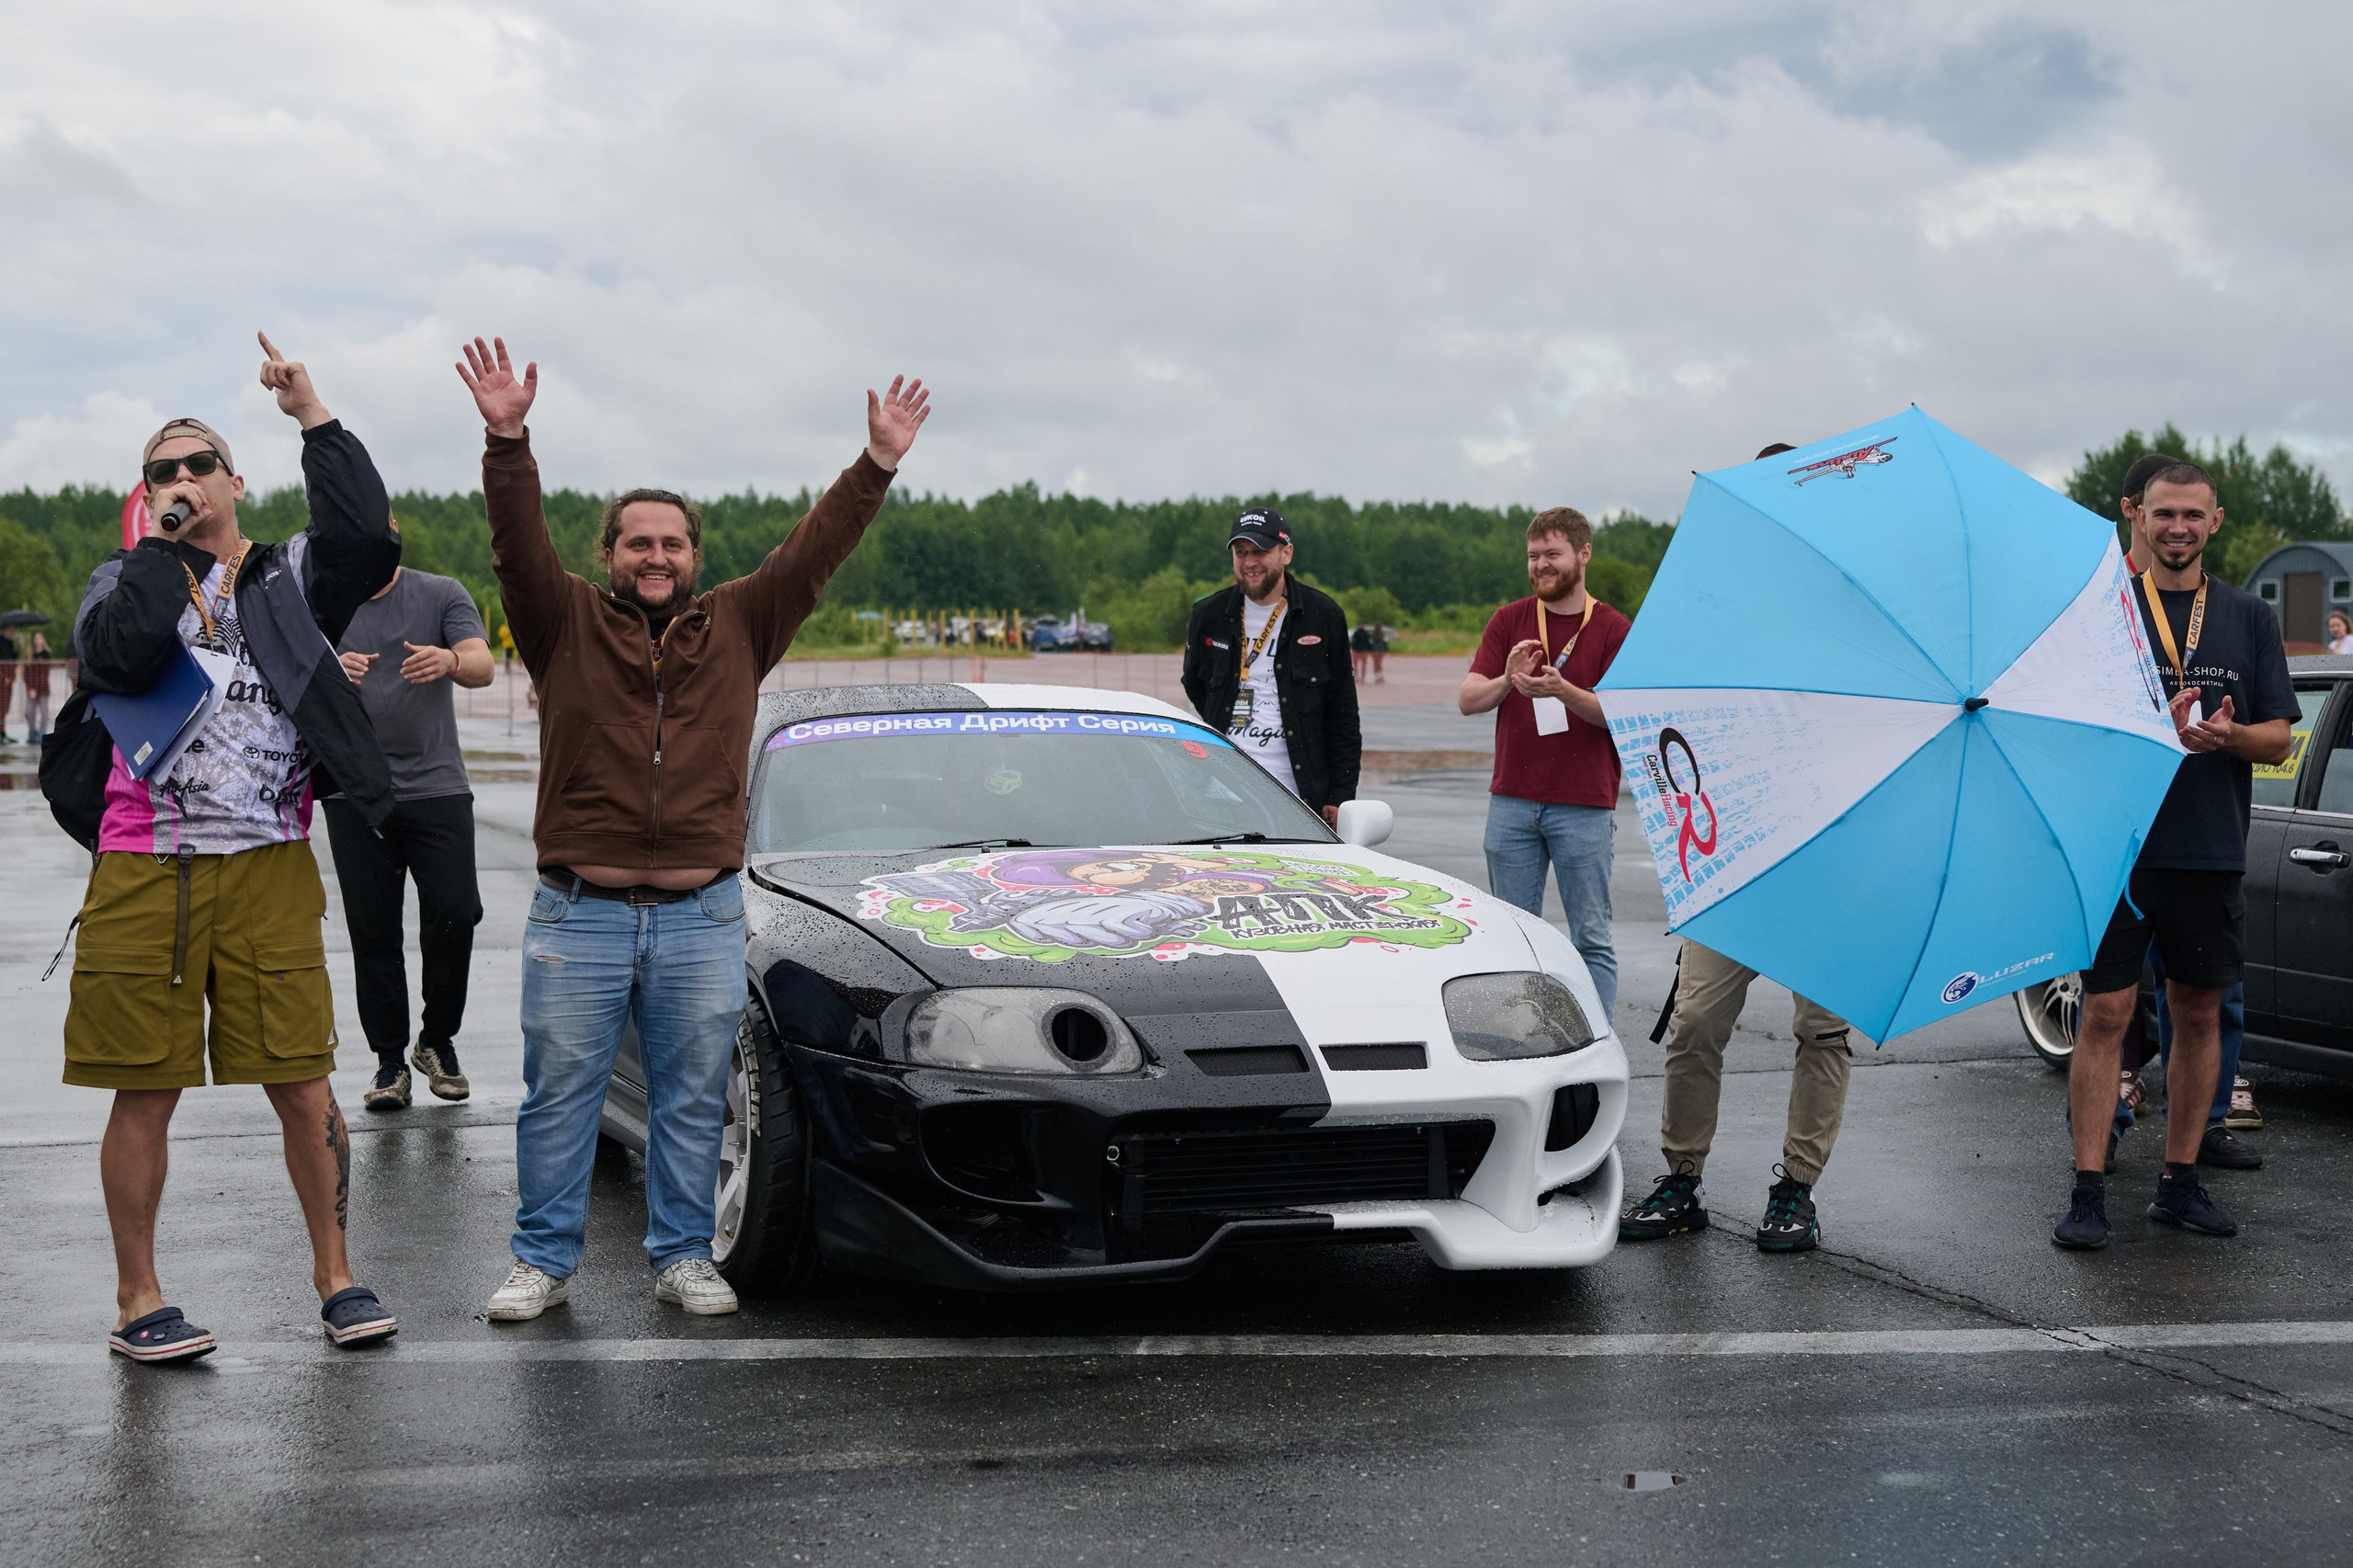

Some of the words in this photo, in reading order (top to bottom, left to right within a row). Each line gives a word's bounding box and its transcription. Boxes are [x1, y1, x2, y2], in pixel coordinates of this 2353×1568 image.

[1256, 611, 1279, 650] CARFEST
[2189, 598, 2204, 645] CARFEST
[789, 715, 951, 740] Северная
[960, 714, 1070, 733] Дрифт
[1077, 714, 1176, 734] Серия
[263, 750, 304, 763] TOYOT
[1182, 740, 1208, 759] 9
[2272, 764, 2295, 774] 104.6
[1232, 922, 1325, 939] КУЗОВНАЯ
[1331, 919, 1441, 931] МАСТЕРСКАЯ
[1979, 952, 2054, 983] LUZAR
